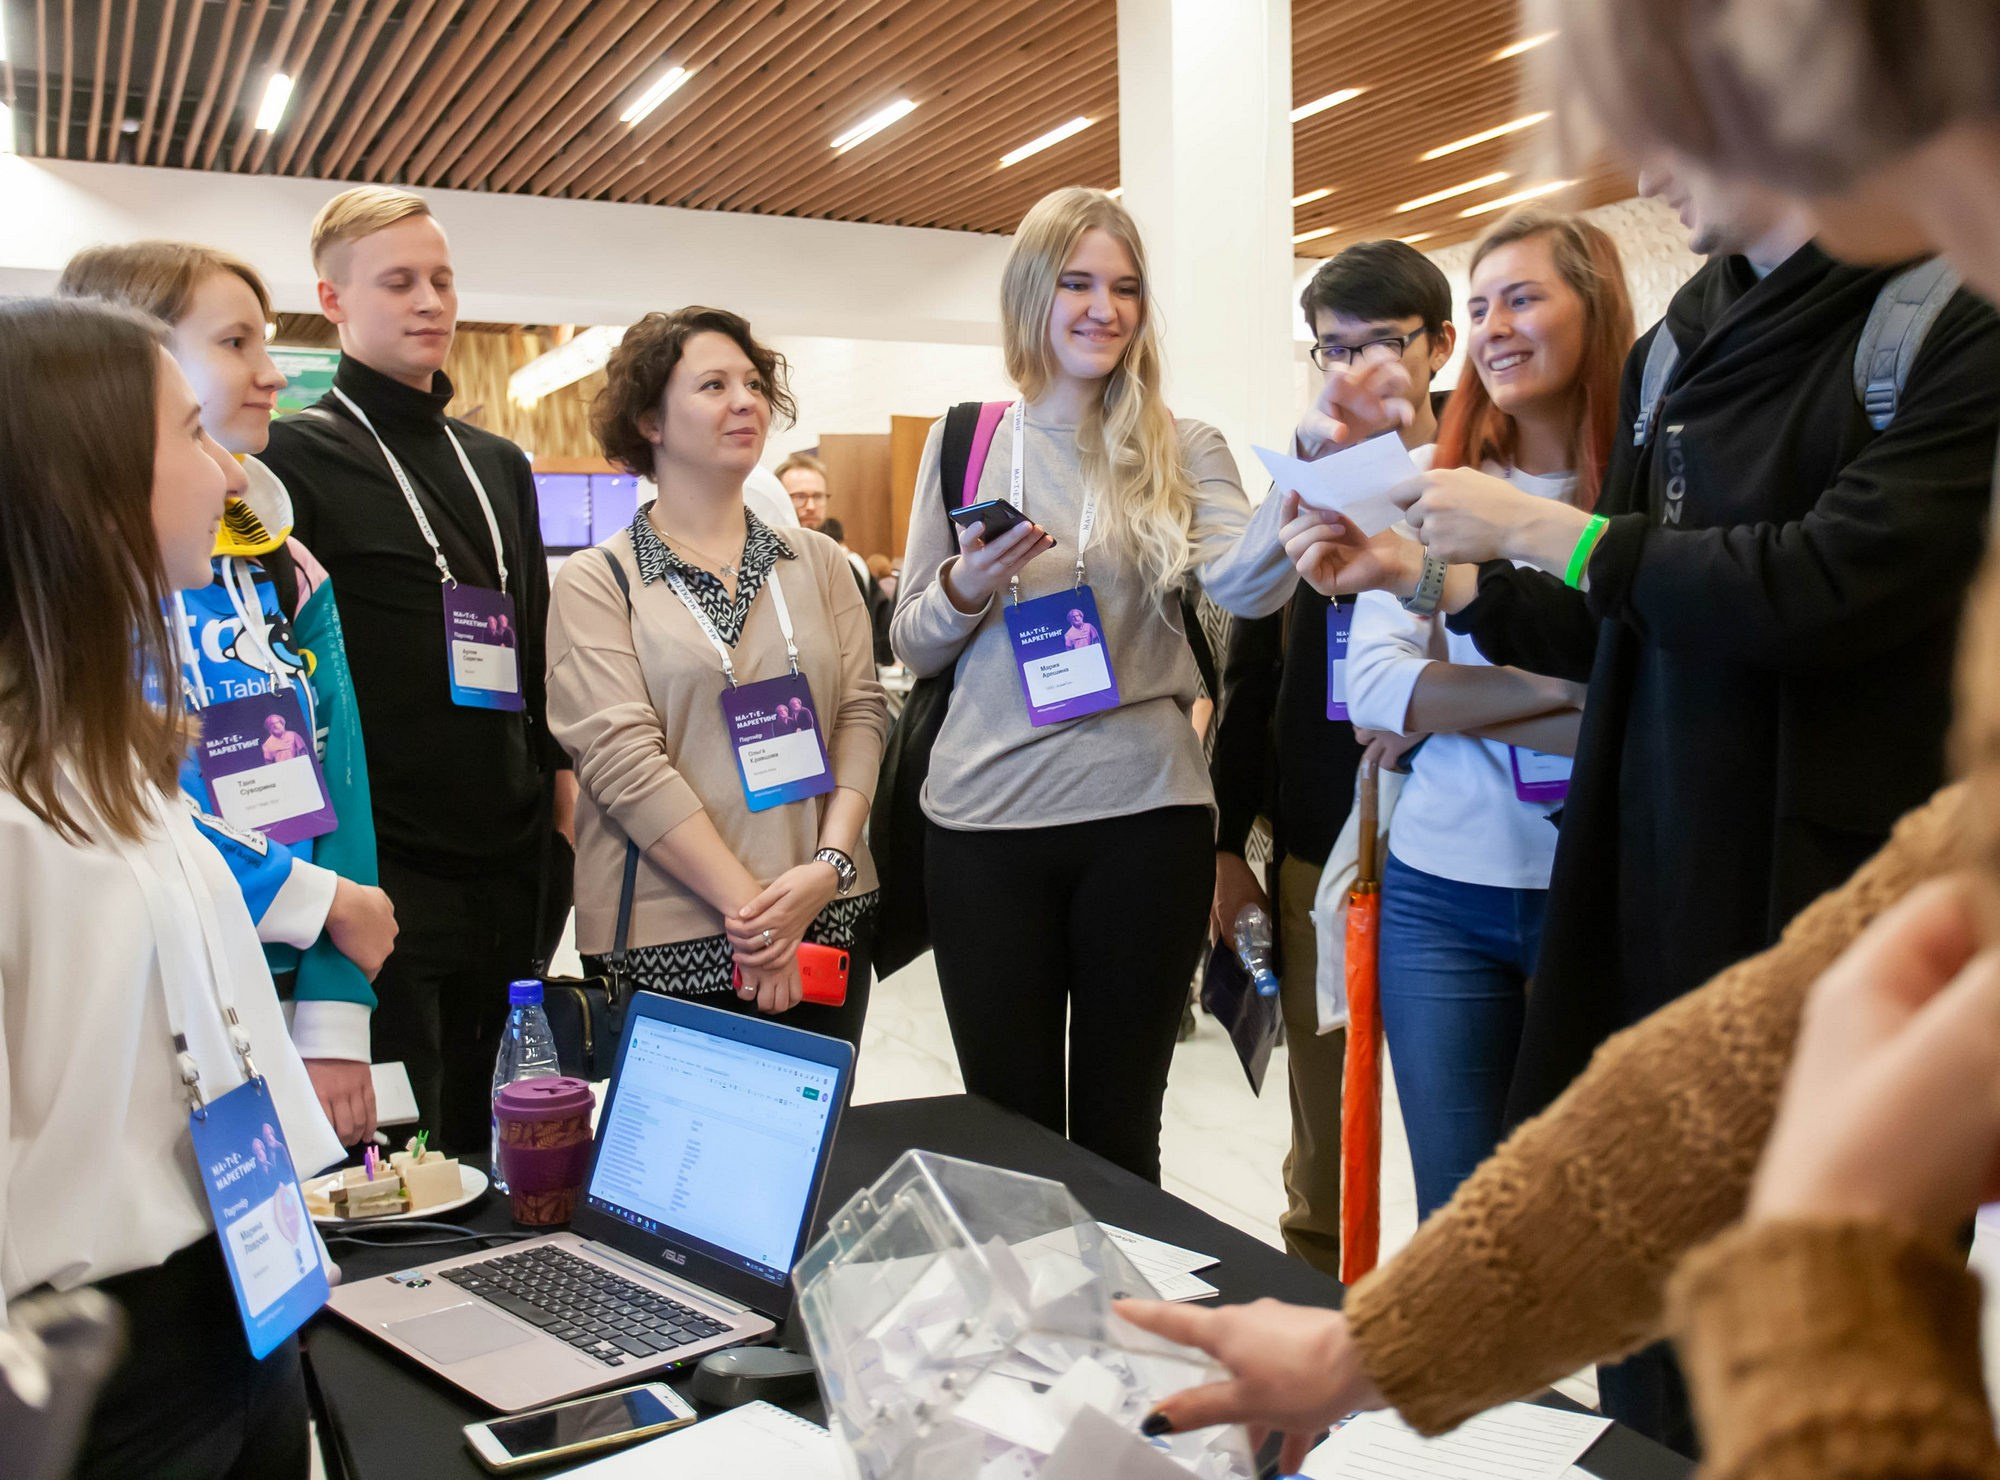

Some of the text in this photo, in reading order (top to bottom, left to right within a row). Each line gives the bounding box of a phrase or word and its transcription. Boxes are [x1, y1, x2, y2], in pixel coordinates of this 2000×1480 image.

[1021, 629, 1063, 645] МАРКЕТИНГ
[219, 678, 296, 700] Tabl
[736, 714, 777, 729] МАРКЕТИНГ
[208, 738, 260, 757] МАРКЕТИНГ
[216, 1157, 256, 1192] МАРКЕТИНГ
[661, 1249, 686, 1266] ASUS
